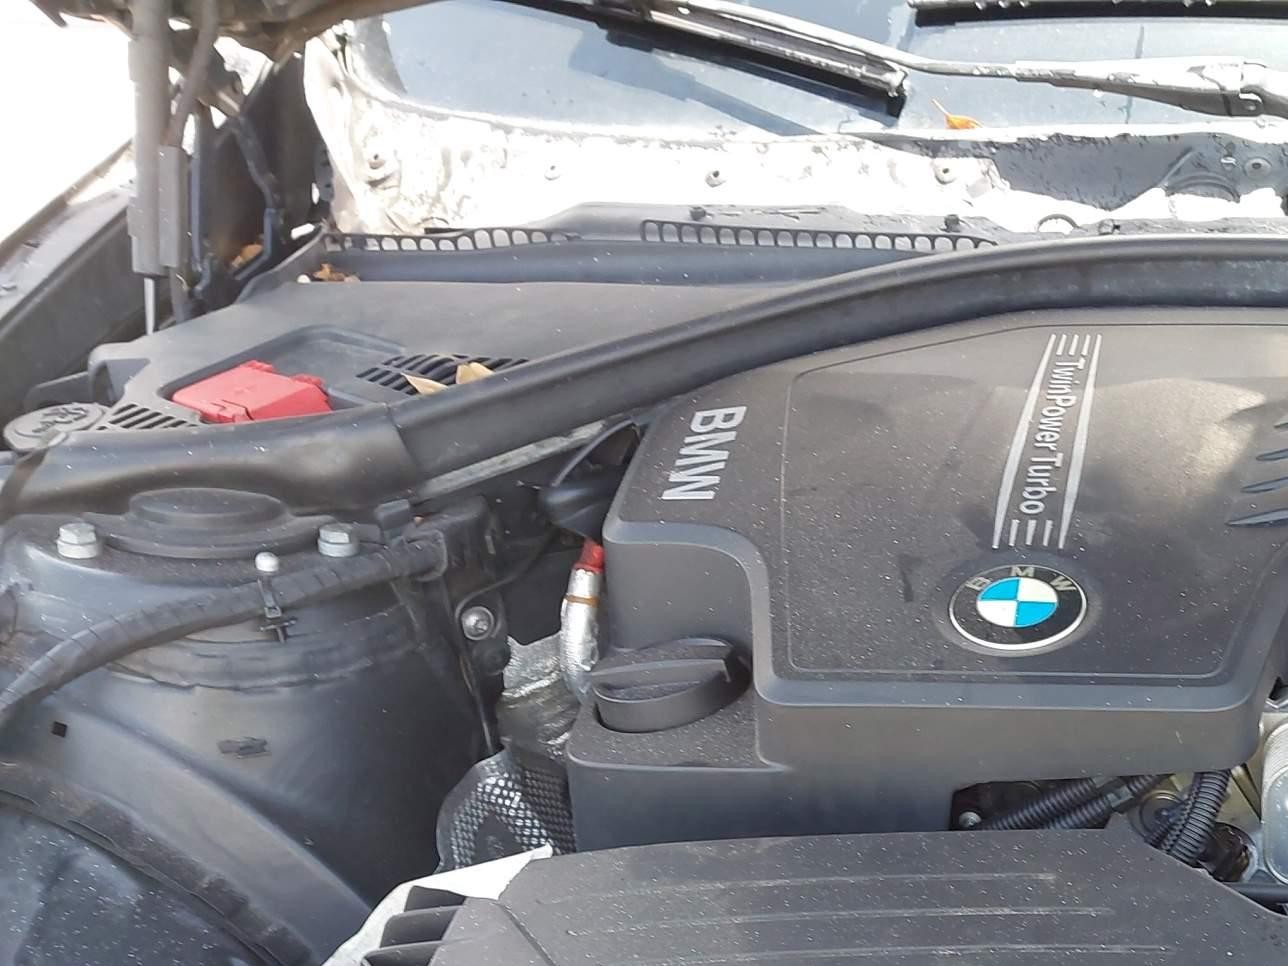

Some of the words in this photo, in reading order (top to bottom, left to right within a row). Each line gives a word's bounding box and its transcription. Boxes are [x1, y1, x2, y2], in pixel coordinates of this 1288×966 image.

[1033, 358, 1087, 451] TwinPower
[661, 406, 747, 500] BMW
[1019, 453, 1064, 515] Turbo
[965, 566, 1078, 591] BMW
